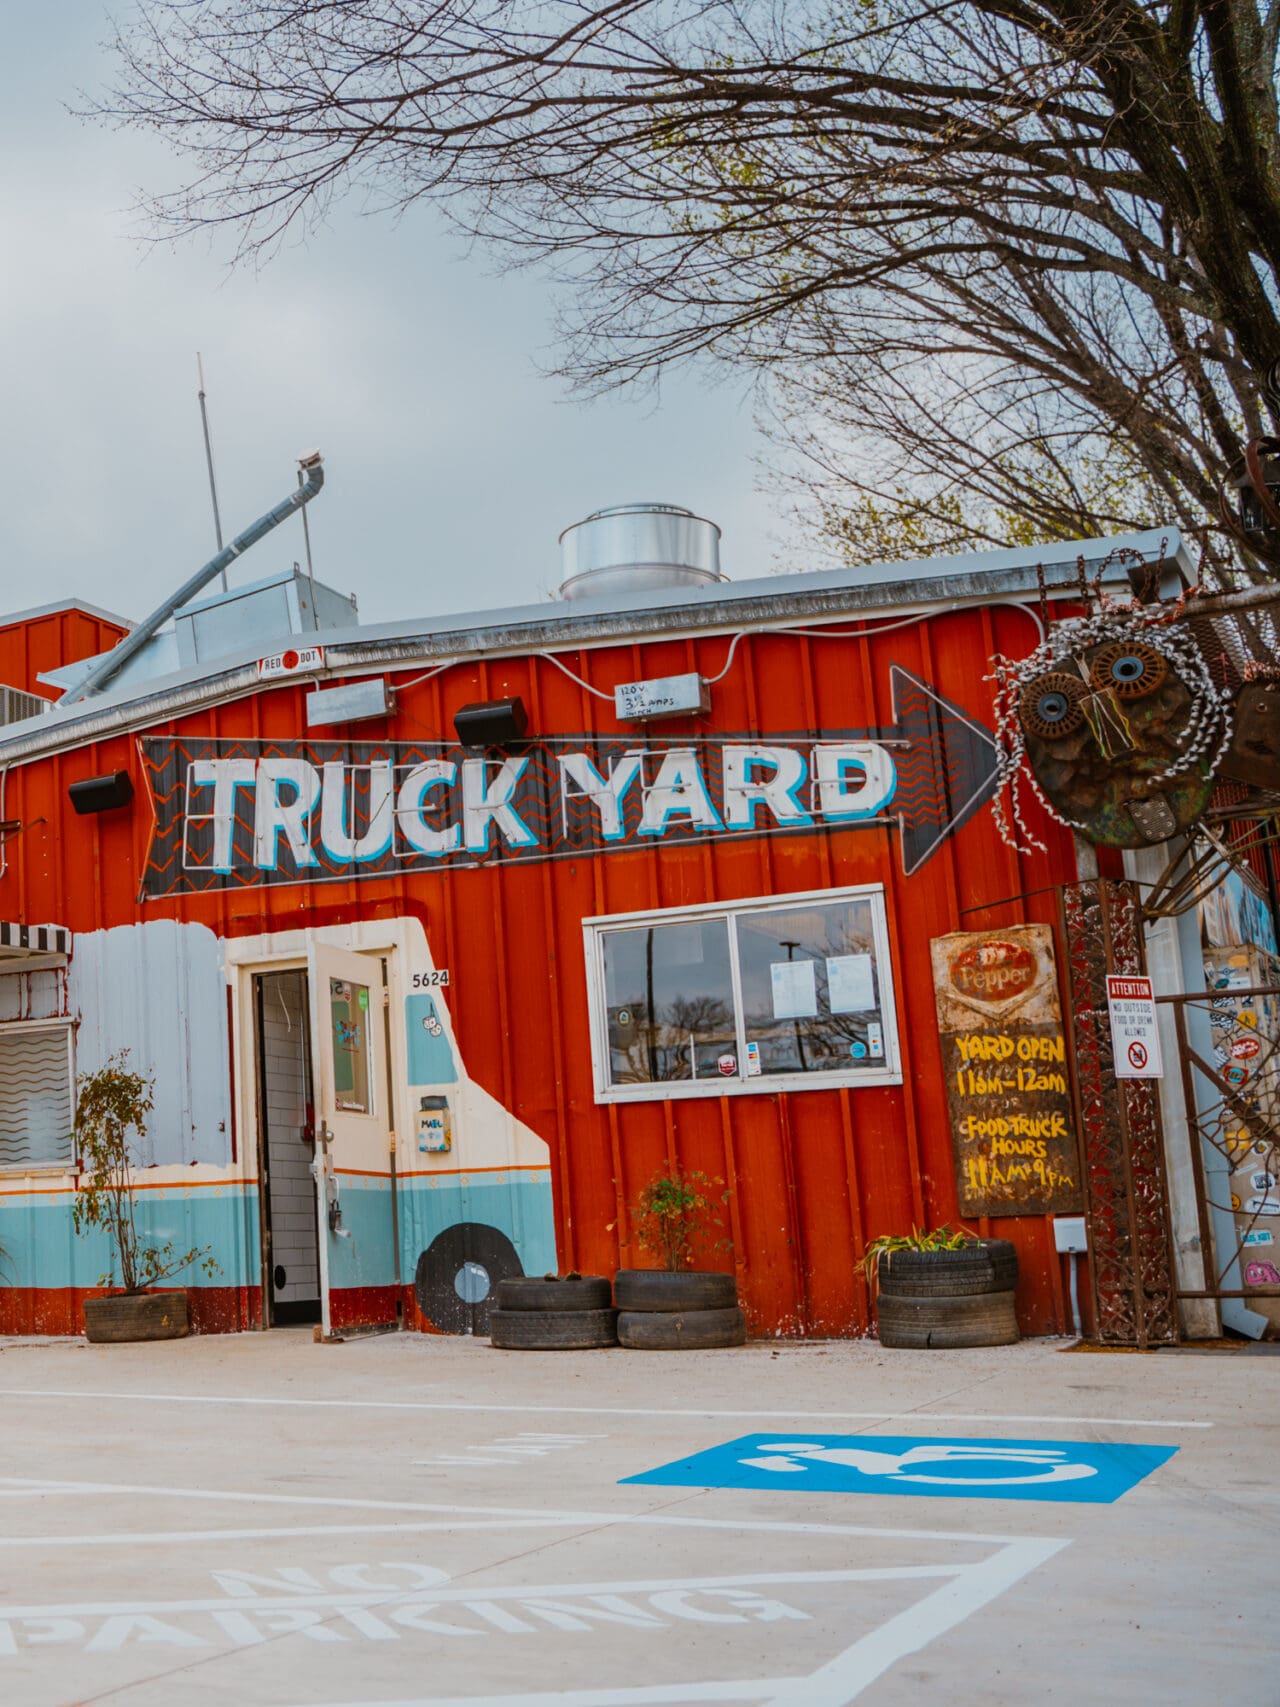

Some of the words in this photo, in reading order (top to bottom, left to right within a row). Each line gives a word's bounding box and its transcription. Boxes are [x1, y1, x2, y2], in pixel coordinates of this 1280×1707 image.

[265, 658, 281, 670] RED
[300, 650, 316, 663] DOT
[190, 758, 540, 874] TRUCK
[556, 742, 899, 838] YARD
[413, 971, 448, 988] 5624
[960, 966, 1031, 993] Pepper
[1112, 982, 1150, 996] ATTENTION
[1113, 1002, 1122, 1012] NO
[1124, 1003, 1152, 1013] OUTSIDE
[1115, 1016, 1127, 1025] FOOD
[1138, 1016, 1153, 1025] DRINK
[1124, 1028, 1146, 1037] ALLOWED
[955, 1033, 1015, 1061] YARD
[1017, 1036, 1065, 1061] OPEN
[421, 1119, 443, 1129] MAIL
[967, 1115, 1010, 1138] FOOD
[1007, 1115, 1068, 1138] TRUCK
[991, 1136, 1047, 1158] HOURS
[210, 1561, 452, 1598] NO
